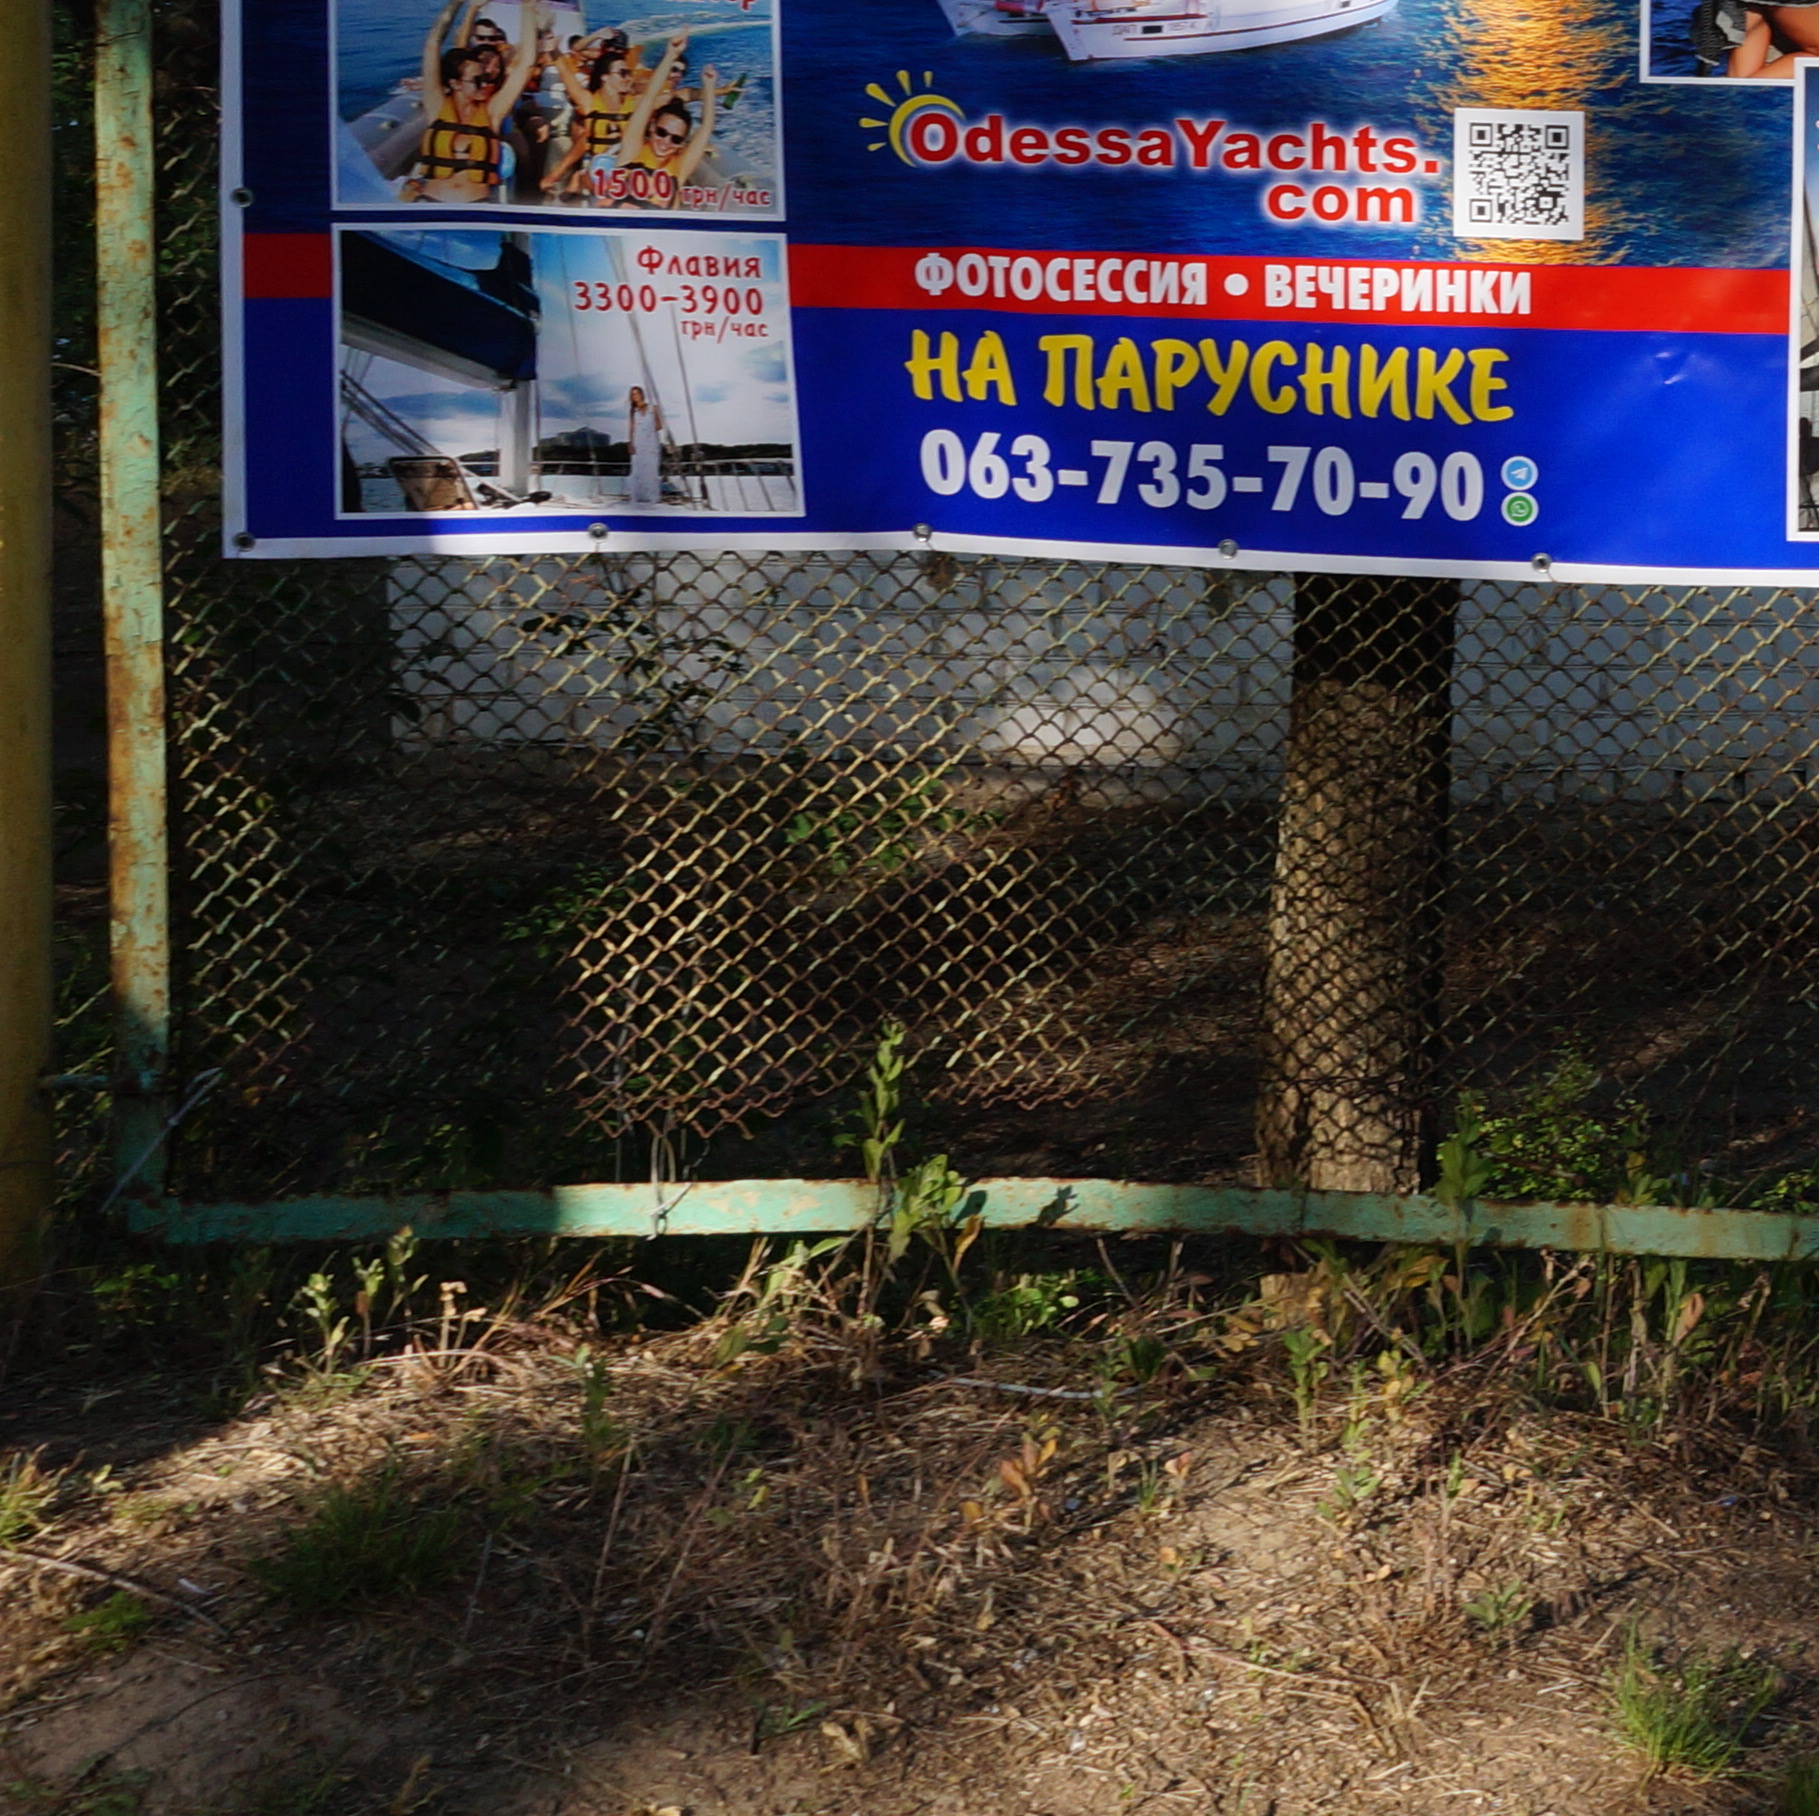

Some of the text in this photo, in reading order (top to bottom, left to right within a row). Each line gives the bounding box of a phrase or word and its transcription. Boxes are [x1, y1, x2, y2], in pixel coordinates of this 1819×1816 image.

[909, 114, 1442, 175] OdessaYachts.
[591, 167, 771, 209] 1500 грн/час
[1265, 184, 1415, 224] com
[636, 244, 762, 279] Флавия
[574, 281, 763, 316] 3300-3900
[914, 252, 1531, 315] ФОТОСЕССИЯ ВЕЧЕРИНКИ
[680, 317, 768, 344] грн/час
[904, 329, 1515, 426] НА ПАРУСНИКЕ
[920, 428, 1484, 522] 063-735-70-90
